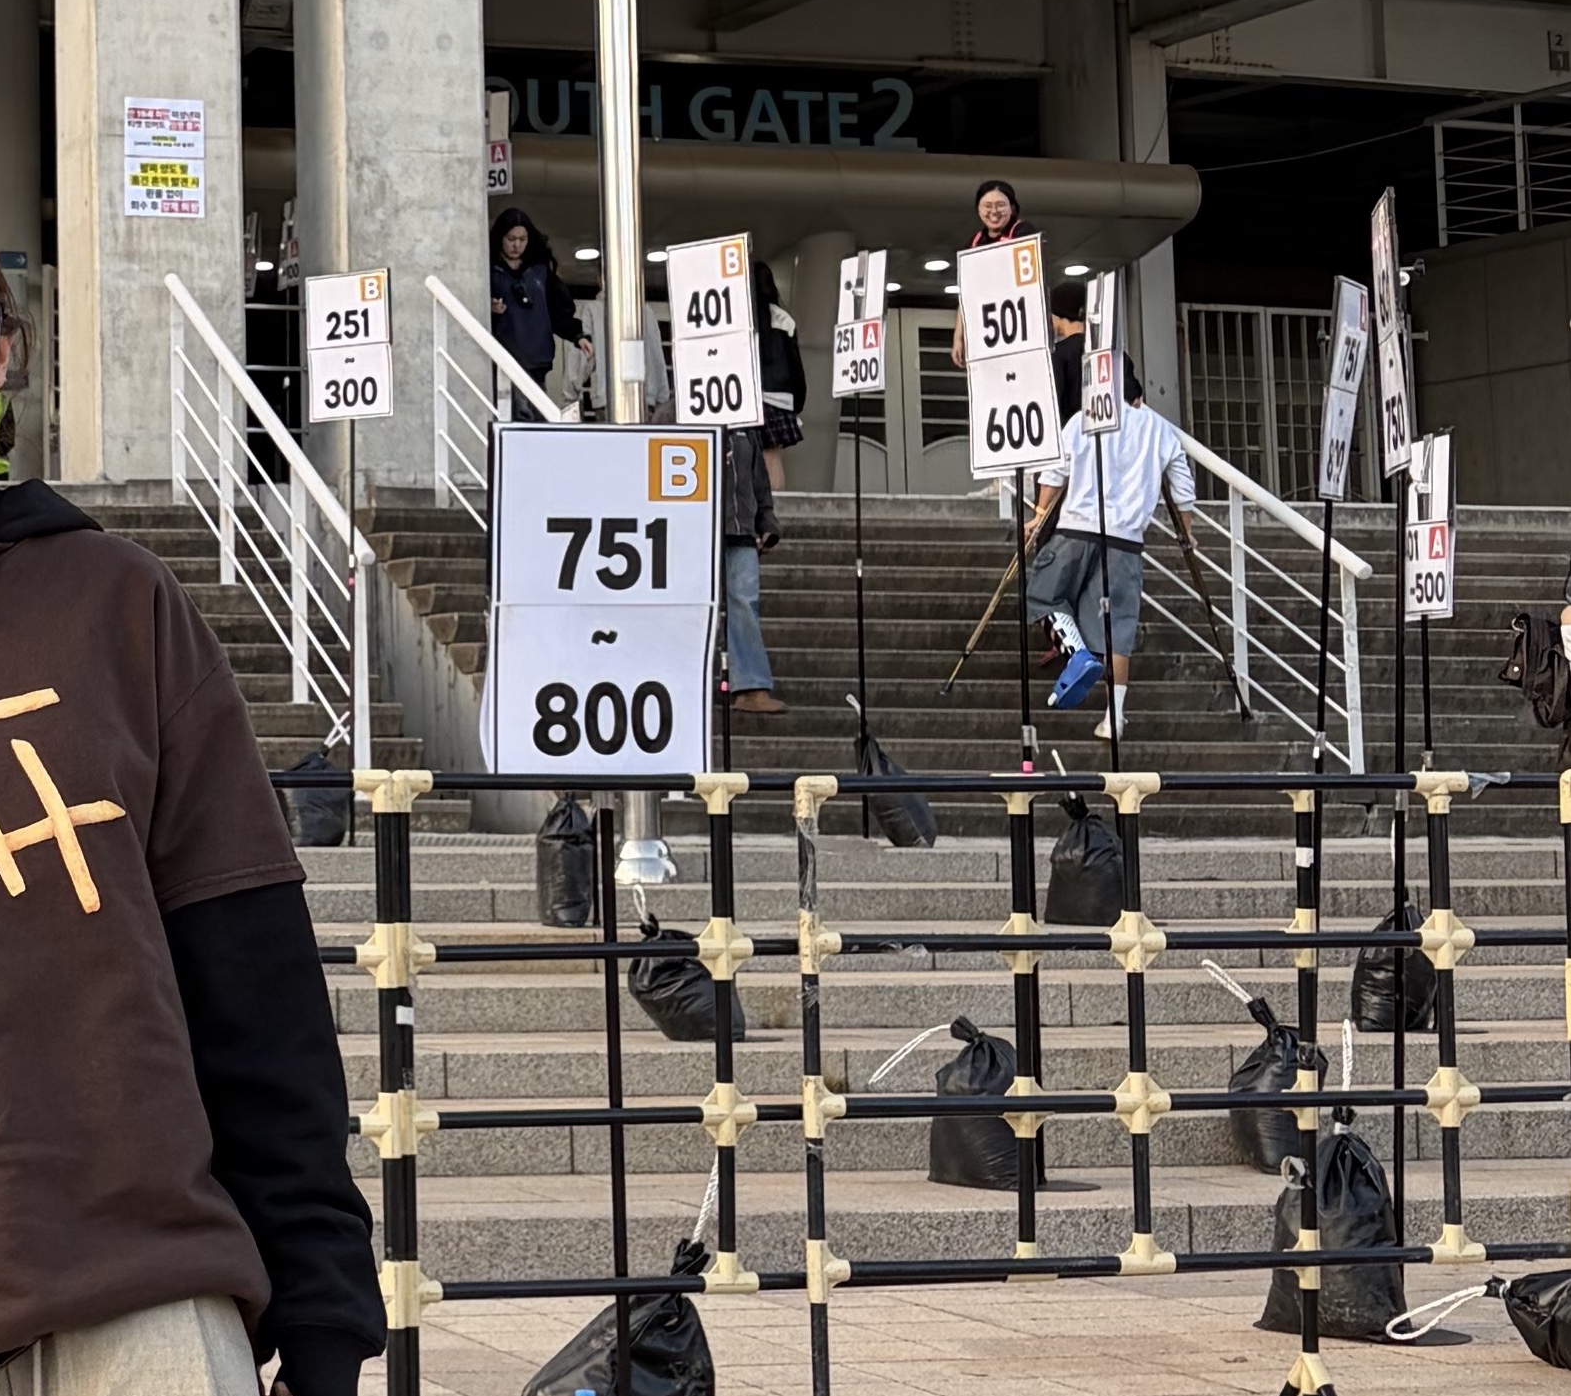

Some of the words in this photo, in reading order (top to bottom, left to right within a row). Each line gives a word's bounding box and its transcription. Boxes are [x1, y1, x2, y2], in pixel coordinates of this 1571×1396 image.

[689, 85, 861, 148] GATE
[872, 77, 919, 150] 2
[486, 167, 508, 188] 50
[726, 243, 742, 276] B
[1018, 249, 1034, 283] B
[364, 276, 380, 301] B
[325, 308, 370, 341] 251
[686, 286, 733, 329] 401
[982, 296, 1028, 348] 501
[836, 326, 855, 355] 251
[866, 325, 877, 348] A
[1099, 356, 1111, 380] A
[324, 376, 378, 409] 300
[689, 373, 743, 417] 500
[986, 400, 1045, 453] 600
[1385, 391, 1406, 454] 750
[661, 444, 699, 498] B
[546, 517, 668, 591] 751
[1432, 529, 1444, 558] A
[533, 680, 674, 757] 800
